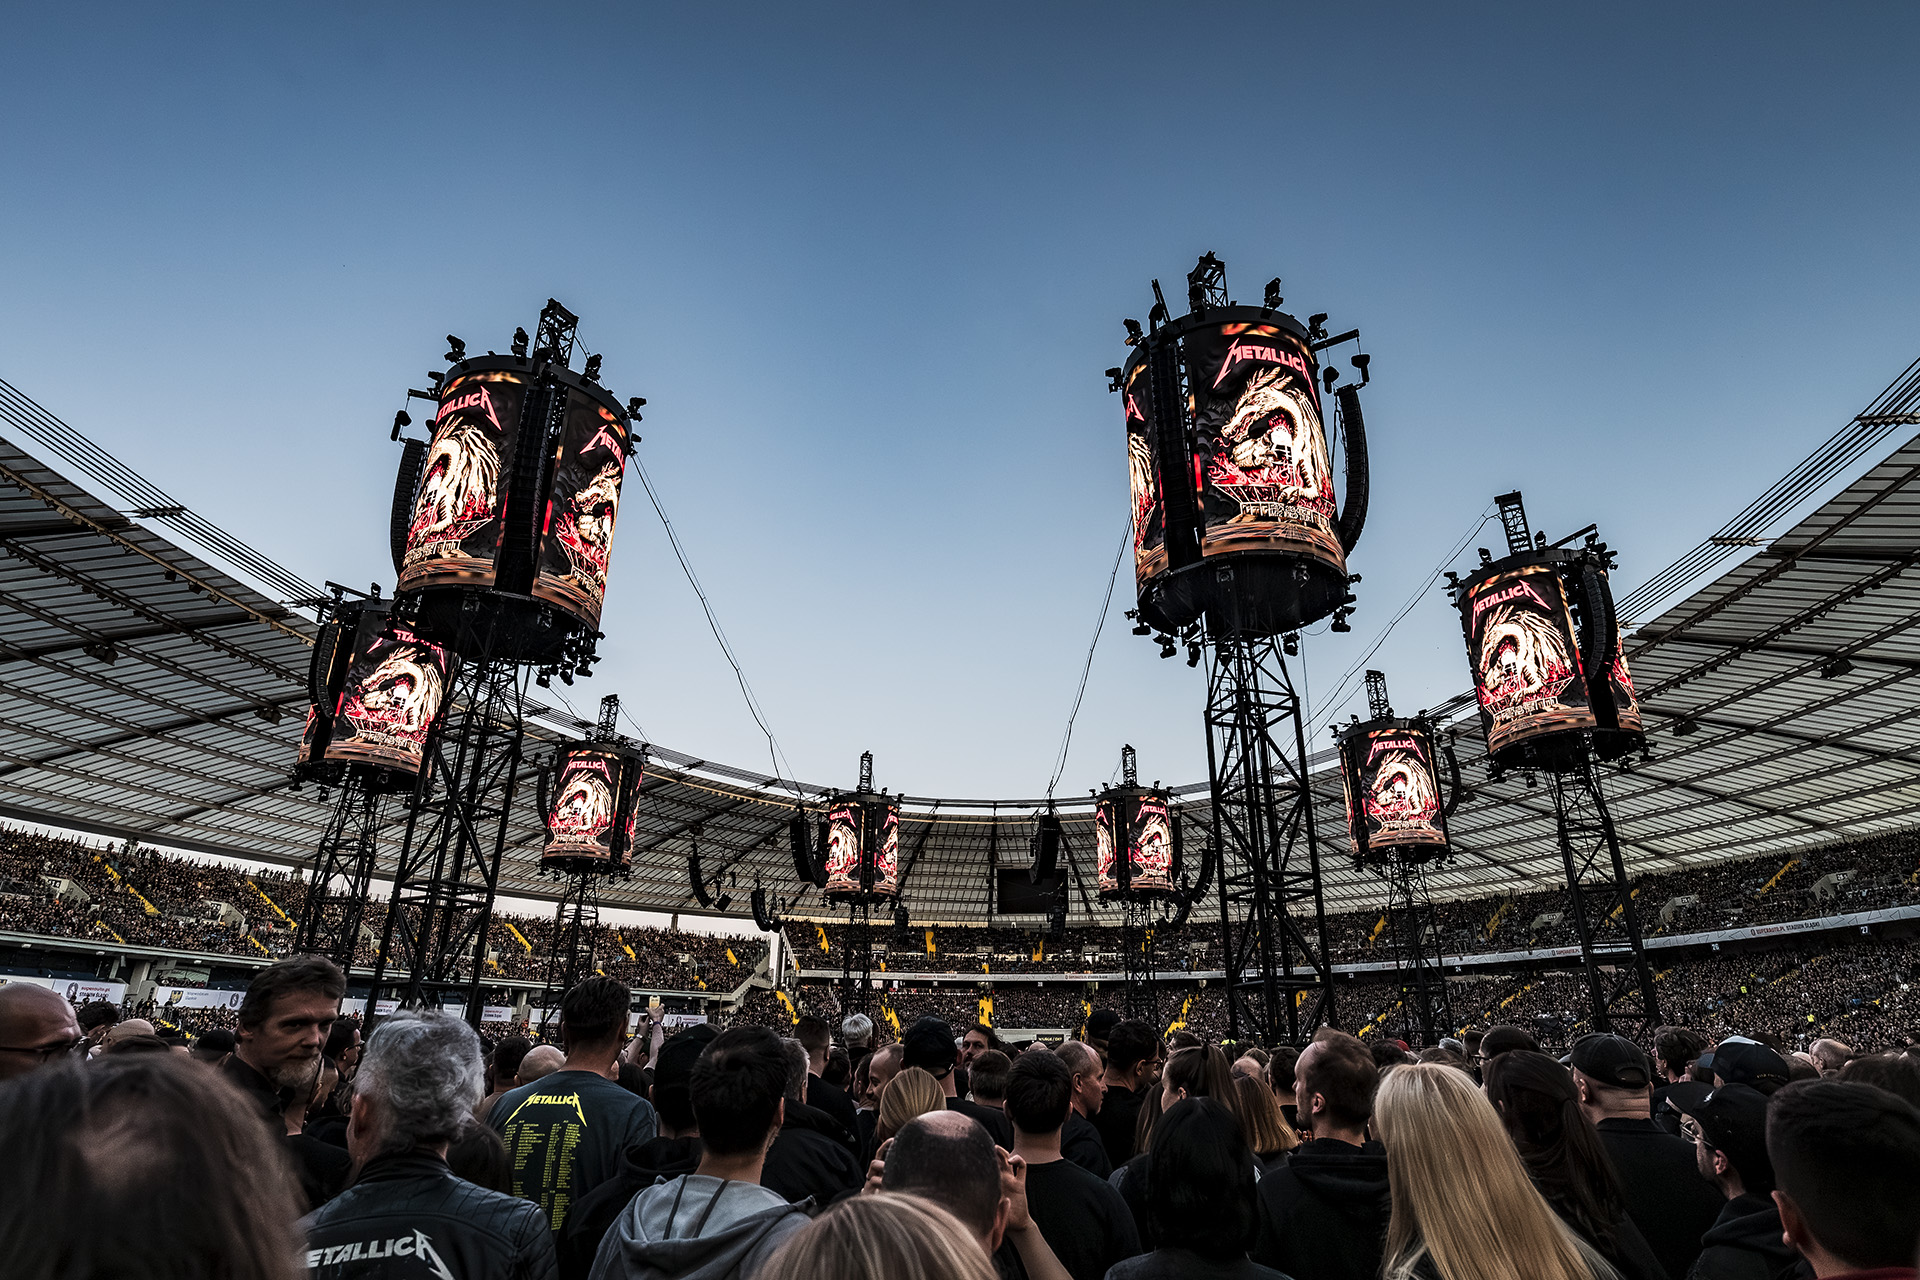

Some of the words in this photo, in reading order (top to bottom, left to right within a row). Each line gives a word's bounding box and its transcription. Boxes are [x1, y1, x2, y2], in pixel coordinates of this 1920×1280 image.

[1472, 579, 1552, 639] METALLICA
[1366, 736, 1426, 766] METALLICA
[560, 758, 612, 783] METALLICA
[504, 1091, 588, 1128] METALLICA
[305, 1227, 455, 1280] ETALLICA
